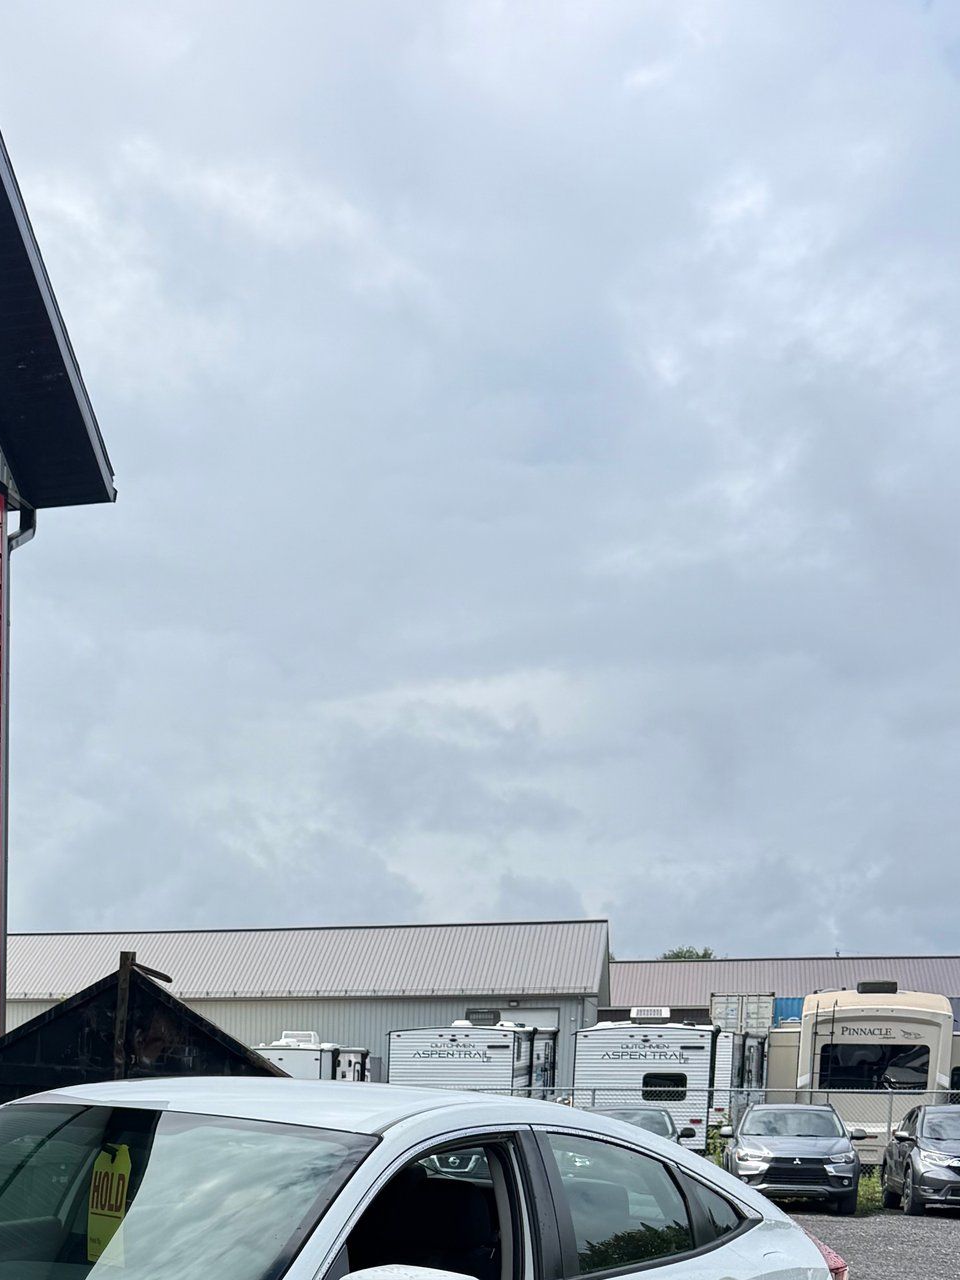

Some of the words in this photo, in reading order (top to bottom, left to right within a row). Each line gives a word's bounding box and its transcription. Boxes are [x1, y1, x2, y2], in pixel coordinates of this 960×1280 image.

[841, 1026, 892, 1036] PINNACLE
[412, 1050, 454, 1058] ASPEN
[455, 1050, 492, 1059] TRAIL
[601, 1051, 647, 1060] ASPEN
[650, 1051, 689, 1060] TRAIL
[91, 1171, 125, 1212] HOLD
